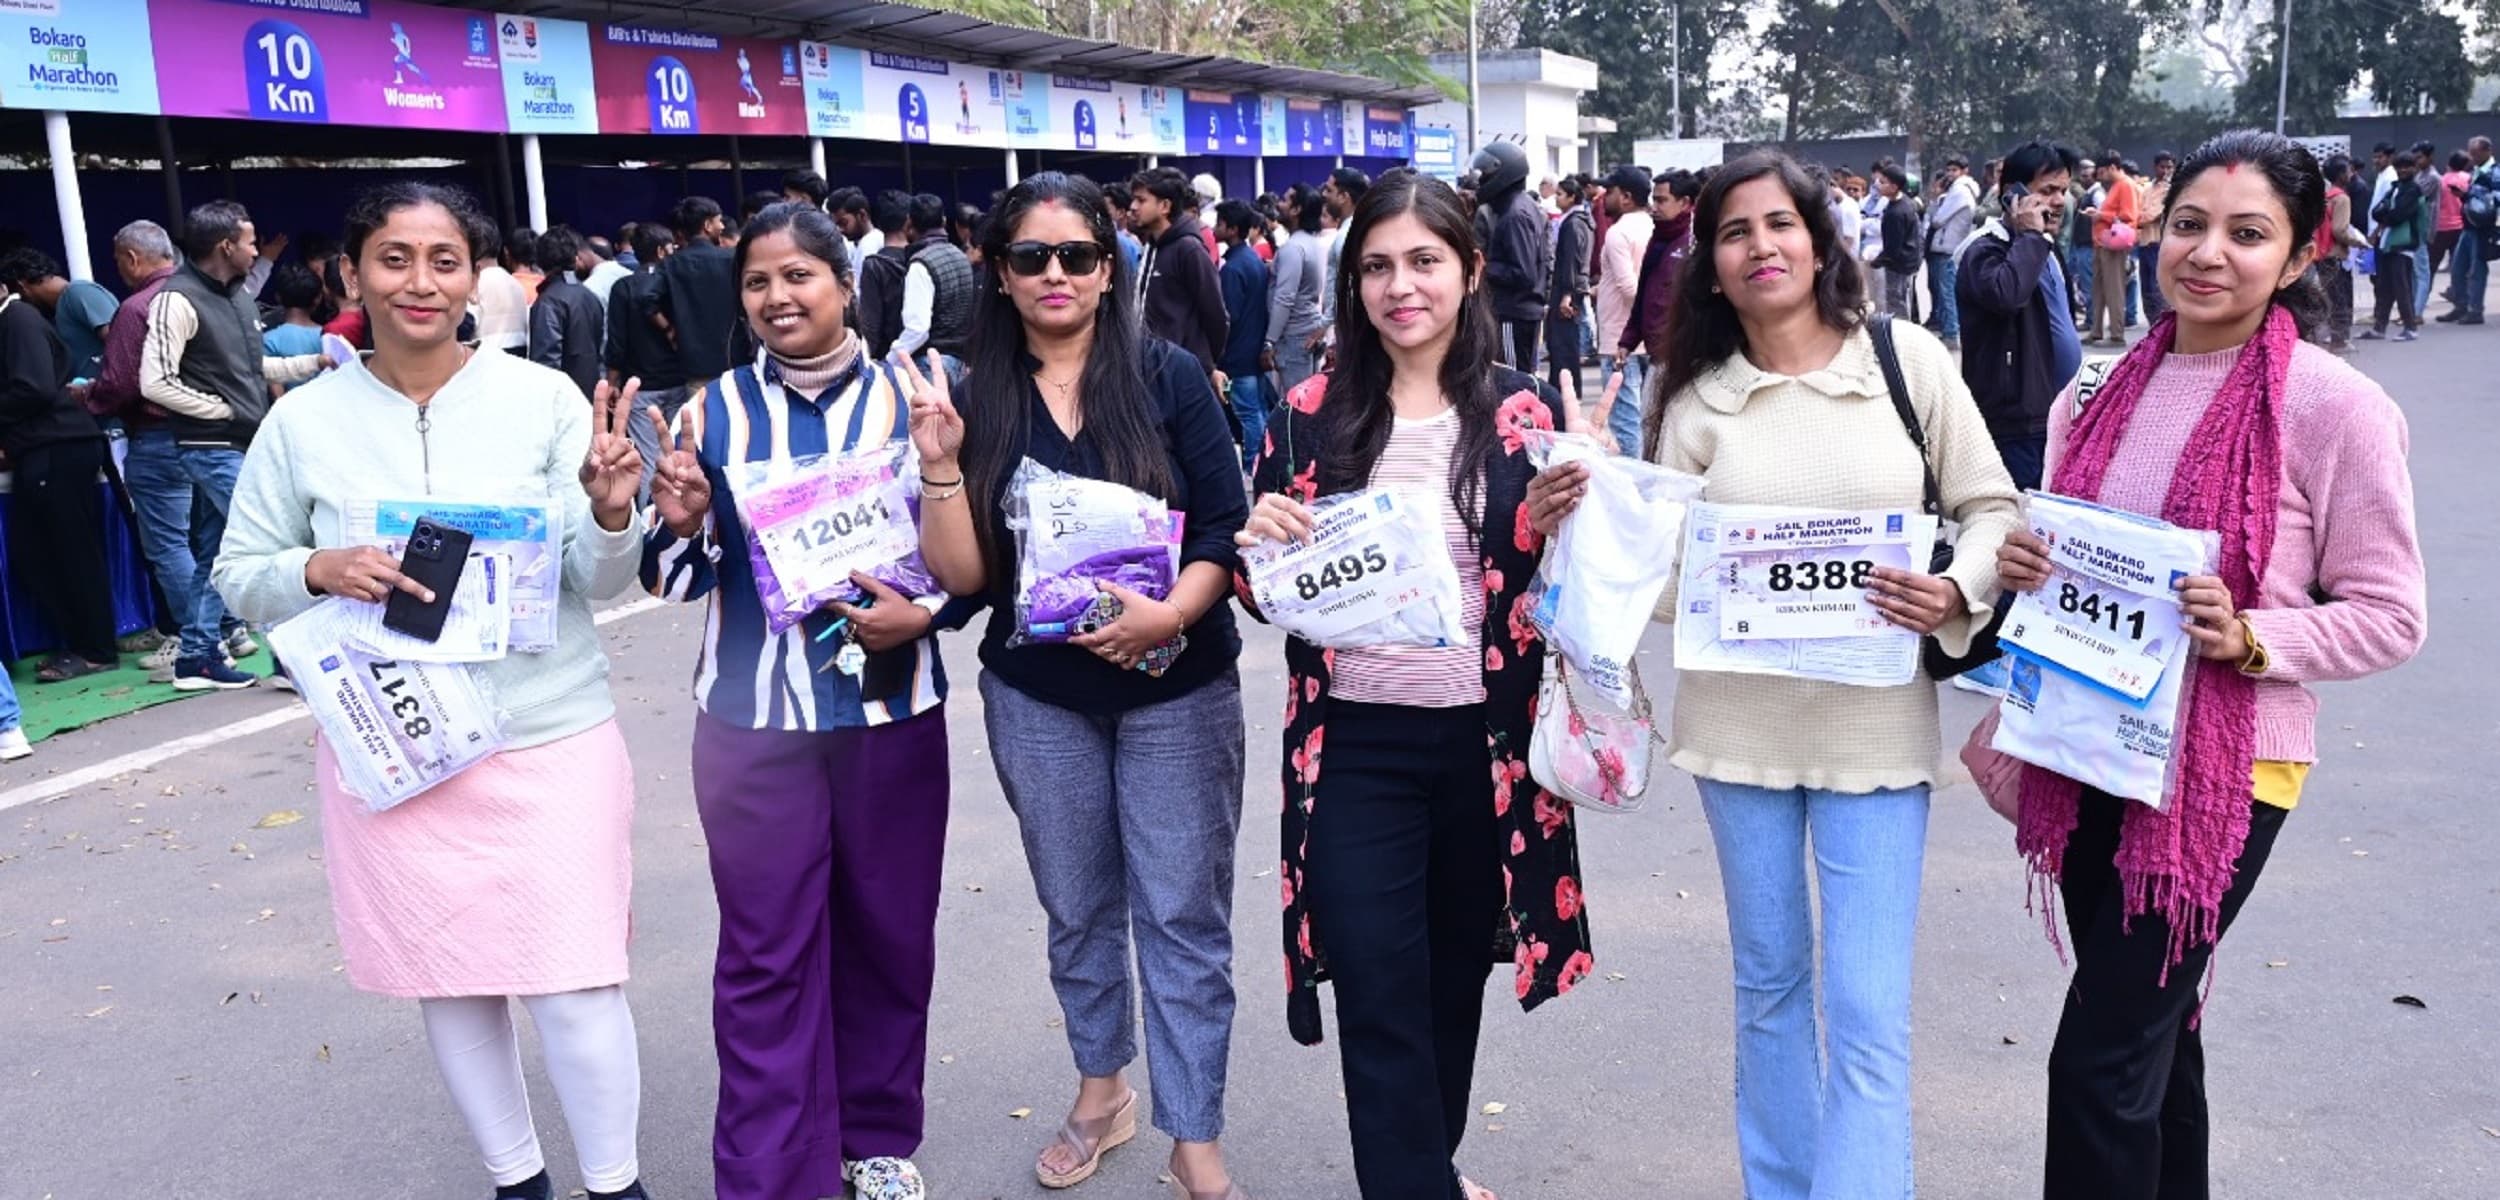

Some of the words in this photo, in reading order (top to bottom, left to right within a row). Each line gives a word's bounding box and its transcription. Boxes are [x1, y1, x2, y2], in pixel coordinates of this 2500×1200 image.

[30, 27, 86, 48] Bokaro
[673, 32, 718, 48] Distribution
[52, 51, 78, 63] Half
[258, 32, 311, 80] 10
[29, 62, 118, 86] Marathon
[524, 72, 556, 86] Bokaro
[655, 66, 688, 102] 10
[266, 82, 315, 114] Km
[384, 87, 444, 110] Women's
[524, 99, 574, 114] Marathon
[910, 92, 919, 117] 5
[660, 105, 690, 128] Km
[1082, 106, 1089, 127] 5
[1210, 116, 1216, 134] 5
[907, 121, 926, 140] Km
[1304, 120, 1310, 137] 5
[1370, 128, 1386, 150] Help
[1388, 132, 1404, 148] Desk
[793, 497, 889, 551] 12041
[1764, 532, 1796, 541] HALF
[1799, 527, 1872, 538] MARATHON
[1776, 522, 1803, 530] SAIL
[1808, 517, 1861, 528] BOKARO
[2061, 544, 2086, 560] HALF
[2087, 556, 2155, 585] MARATHON
[2068, 536, 2093, 551] SAIL
[2096, 547, 2145, 570] BOKARO
[1295, 544, 1386, 600] 8495
[1768, 560, 1874, 592] 8388
[1776, 604, 1810, 614] KIRAN
[1812, 604, 1856, 613] KUMARI
[2059, 582, 2144, 640] 8411
[1738, 621, 1749, 632] B
[2014, 624, 2024, 637] B
[340, 677, 376, 733] MARATHON
[369, 660, 432, 740] 8317
[336, 690, 364, 734] BOKARO
[374, 732, 392, 760] HALF
[468, 732, 480, 742] B
